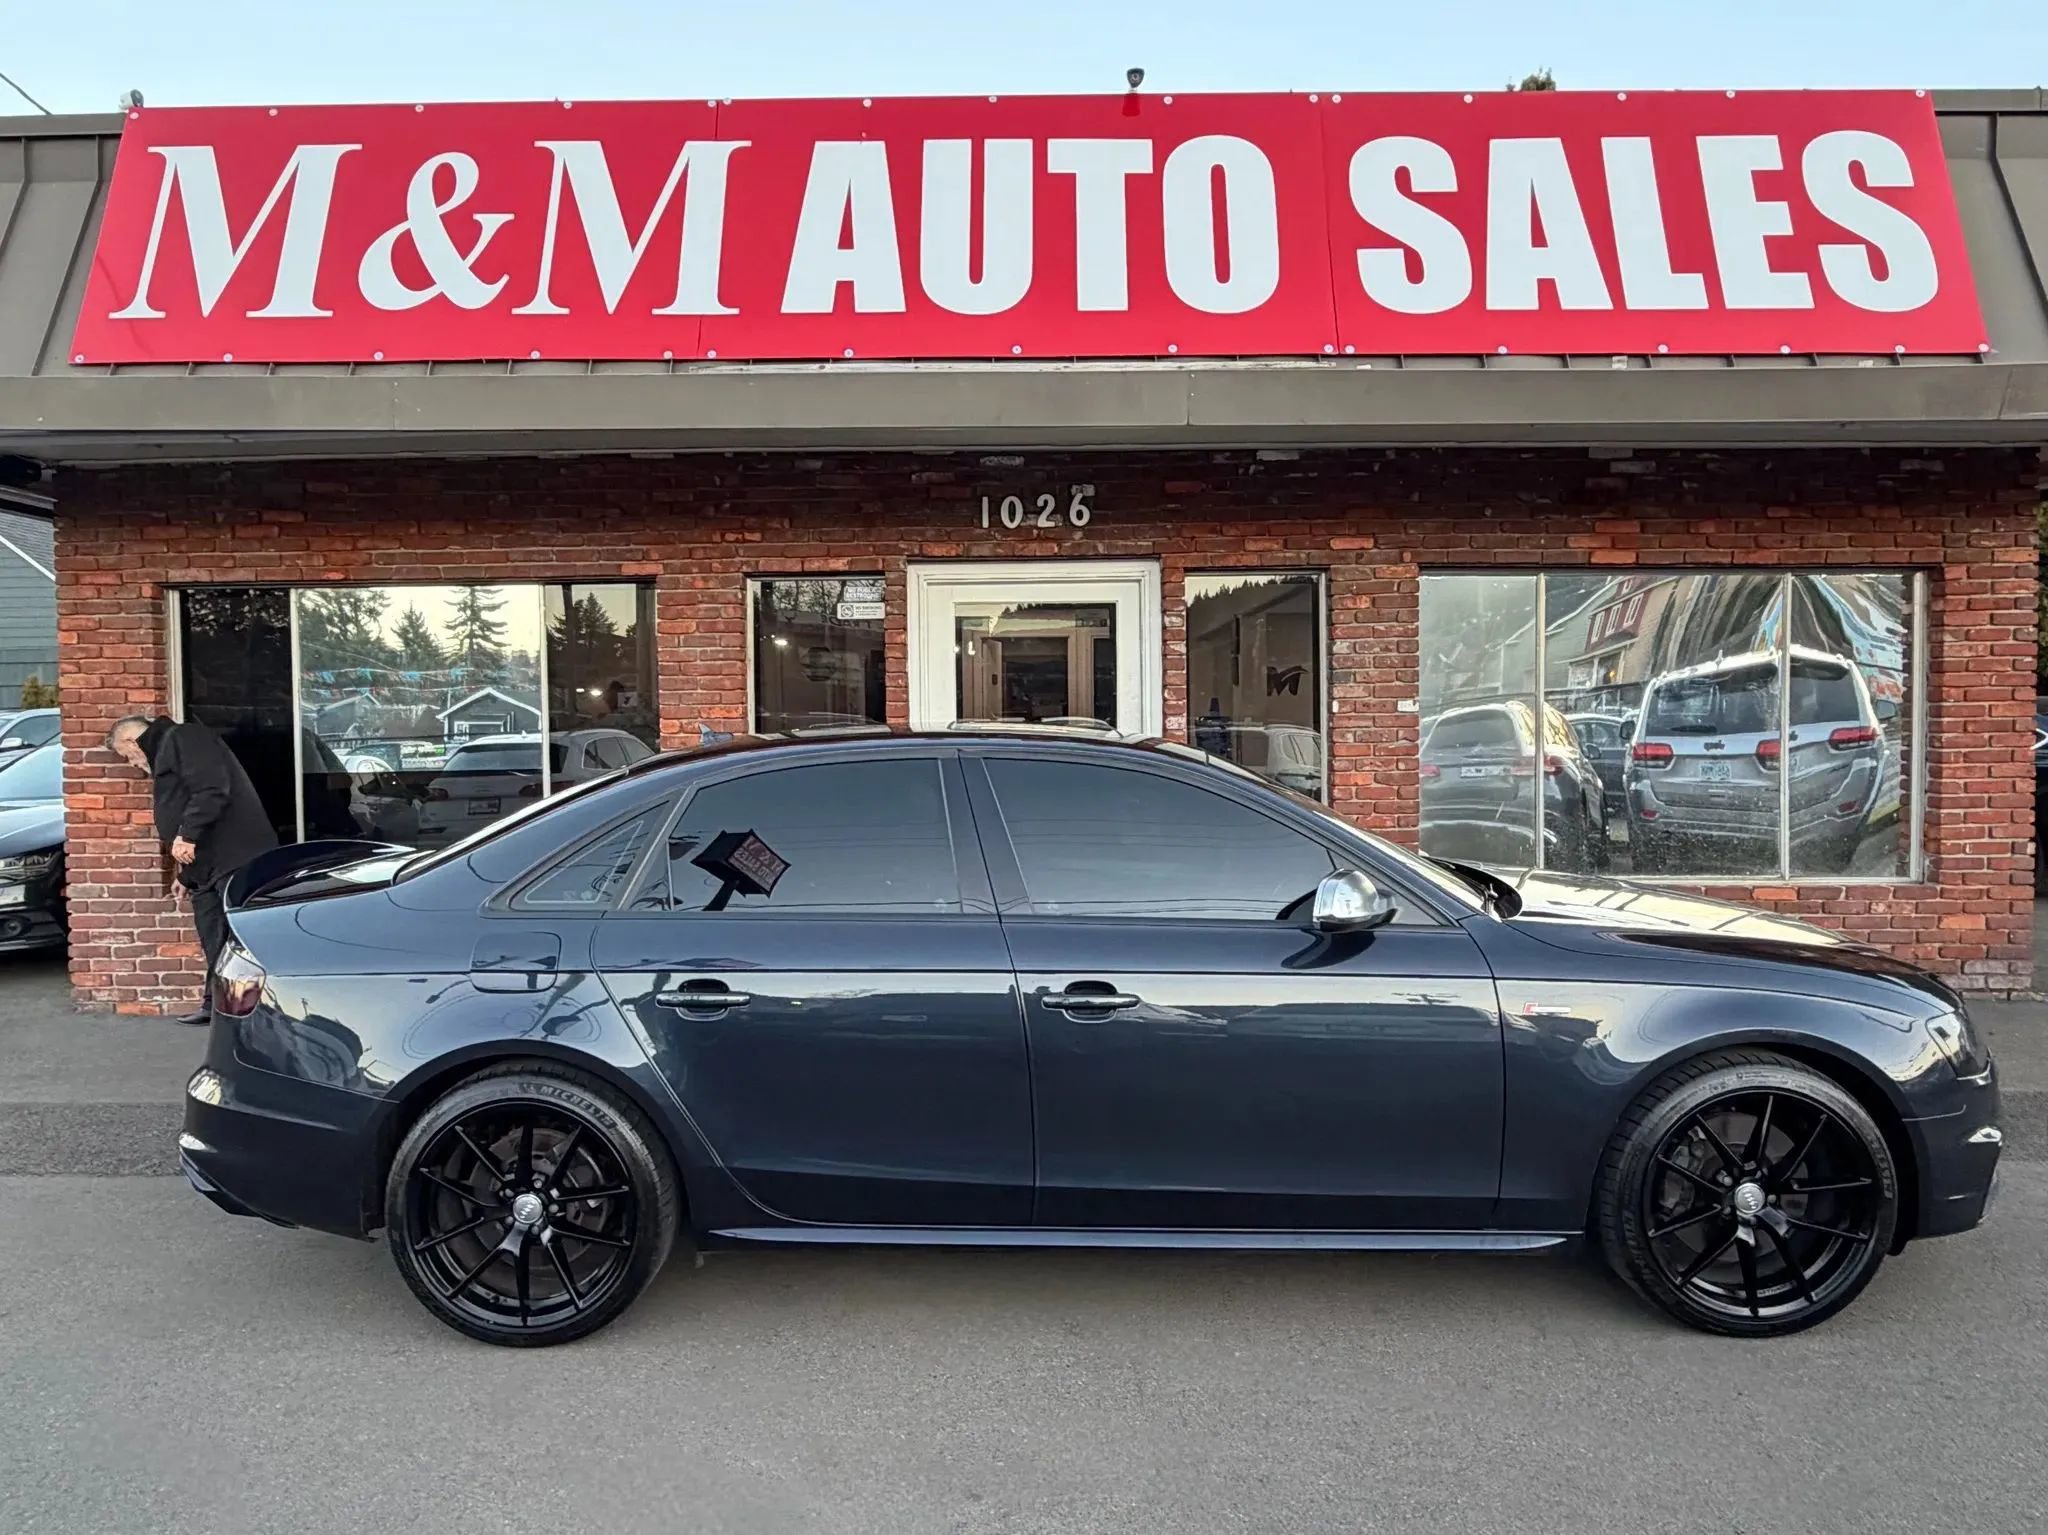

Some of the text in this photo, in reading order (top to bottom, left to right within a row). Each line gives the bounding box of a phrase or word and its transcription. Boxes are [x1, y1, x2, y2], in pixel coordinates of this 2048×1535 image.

[108, 130, 1939, 318] M&M AUTO SALES
[981, 493, 1091, 529] 1026
